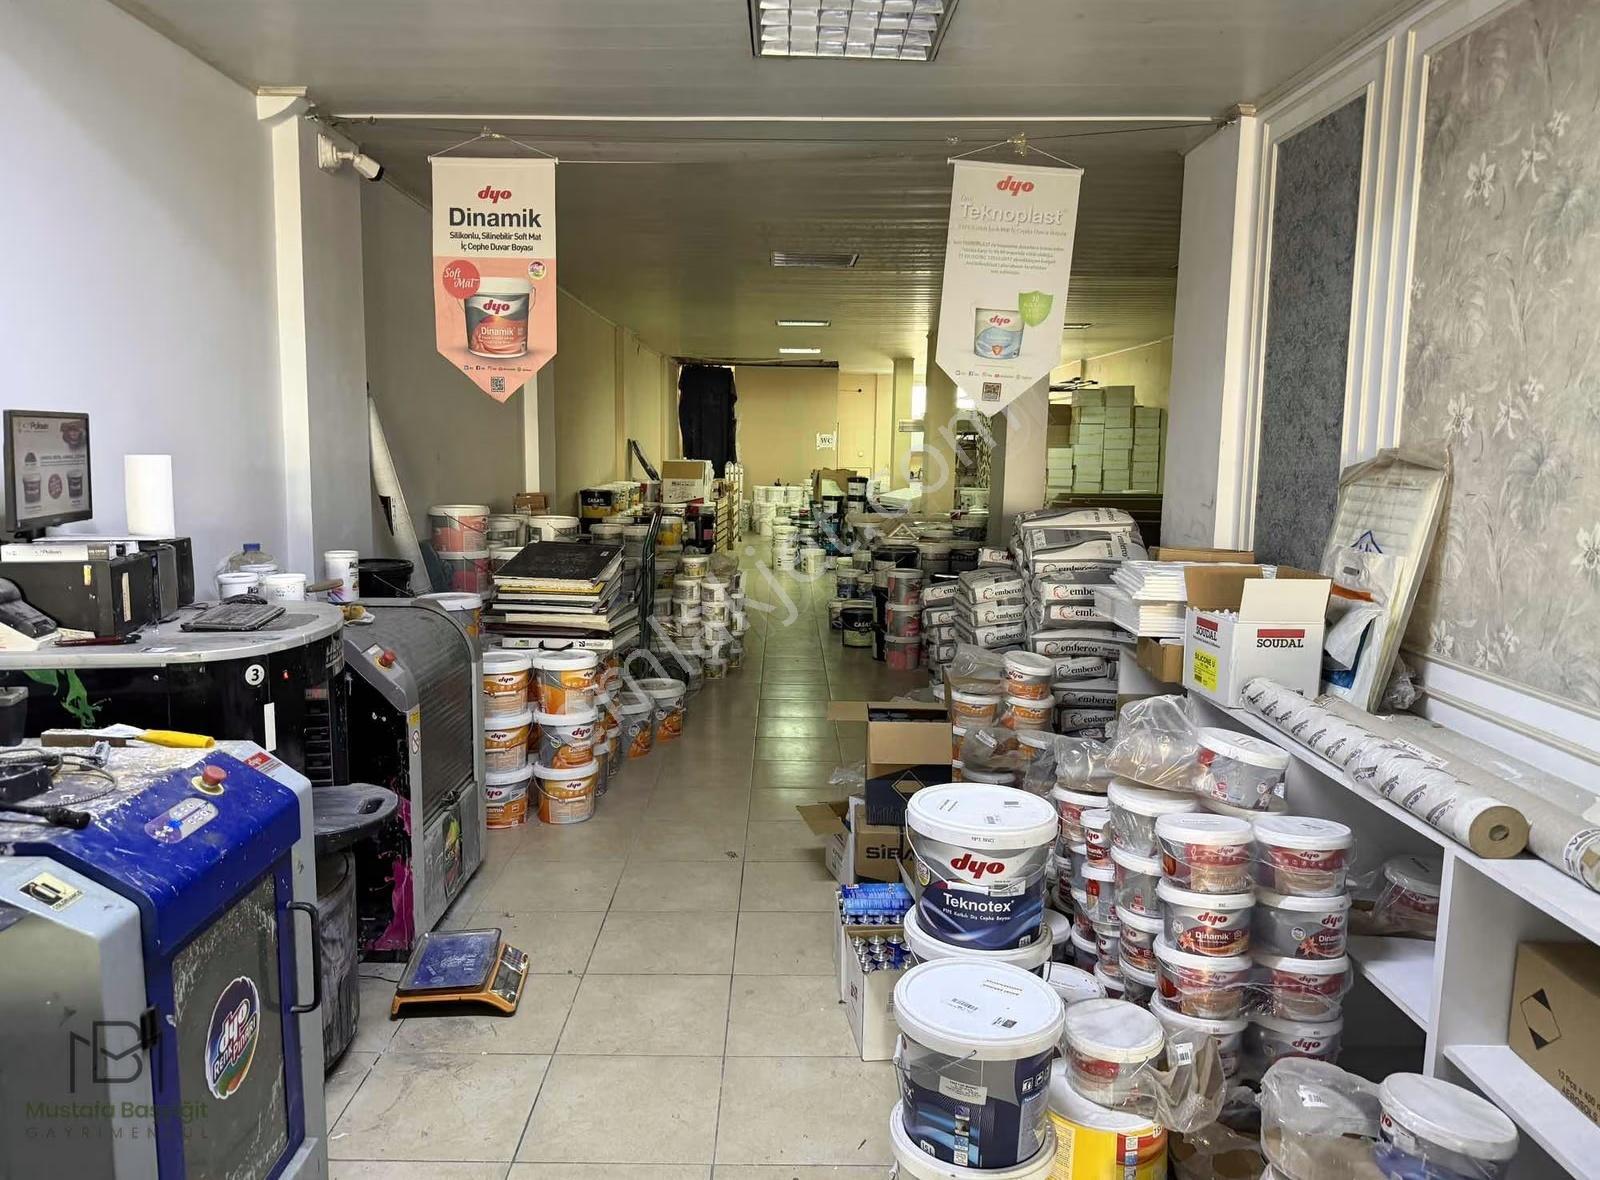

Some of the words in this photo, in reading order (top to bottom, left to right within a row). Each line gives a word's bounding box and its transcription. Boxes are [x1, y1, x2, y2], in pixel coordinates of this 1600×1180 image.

[997, 176, 1035, 196] dyo
[478, 186, 512, 203] dyo
[449, 207, 542, 227] Dinamik
[468, 243, 489, 252] Cephe
[490, 243, 510, 251] Duvar
[483, 300, 510, 314] dyo
[990, 315, 1010, 326] dyo
[1256, 639, 1304, 648] SOUDAL
[251, 668, 260, 681] 3
[572, 728, 591, 737] dyo
[486, 788, 502, 799] yo
[1086, 828, 1099, 840] yo
[1217, 848, 1234, 856] dyo
[1300, 851, 1320, 860] dyo
[949, 853, 1005, 879] dyo
[943, 893, 1012, 912] Teknotex
[1197, 912, 1228, 926] dyo
[1321, 914, 1343, 927] dyo
[1195, 931, 1229, 940] Dinamik
[1292, 1038, 1321, 1051] dyo
